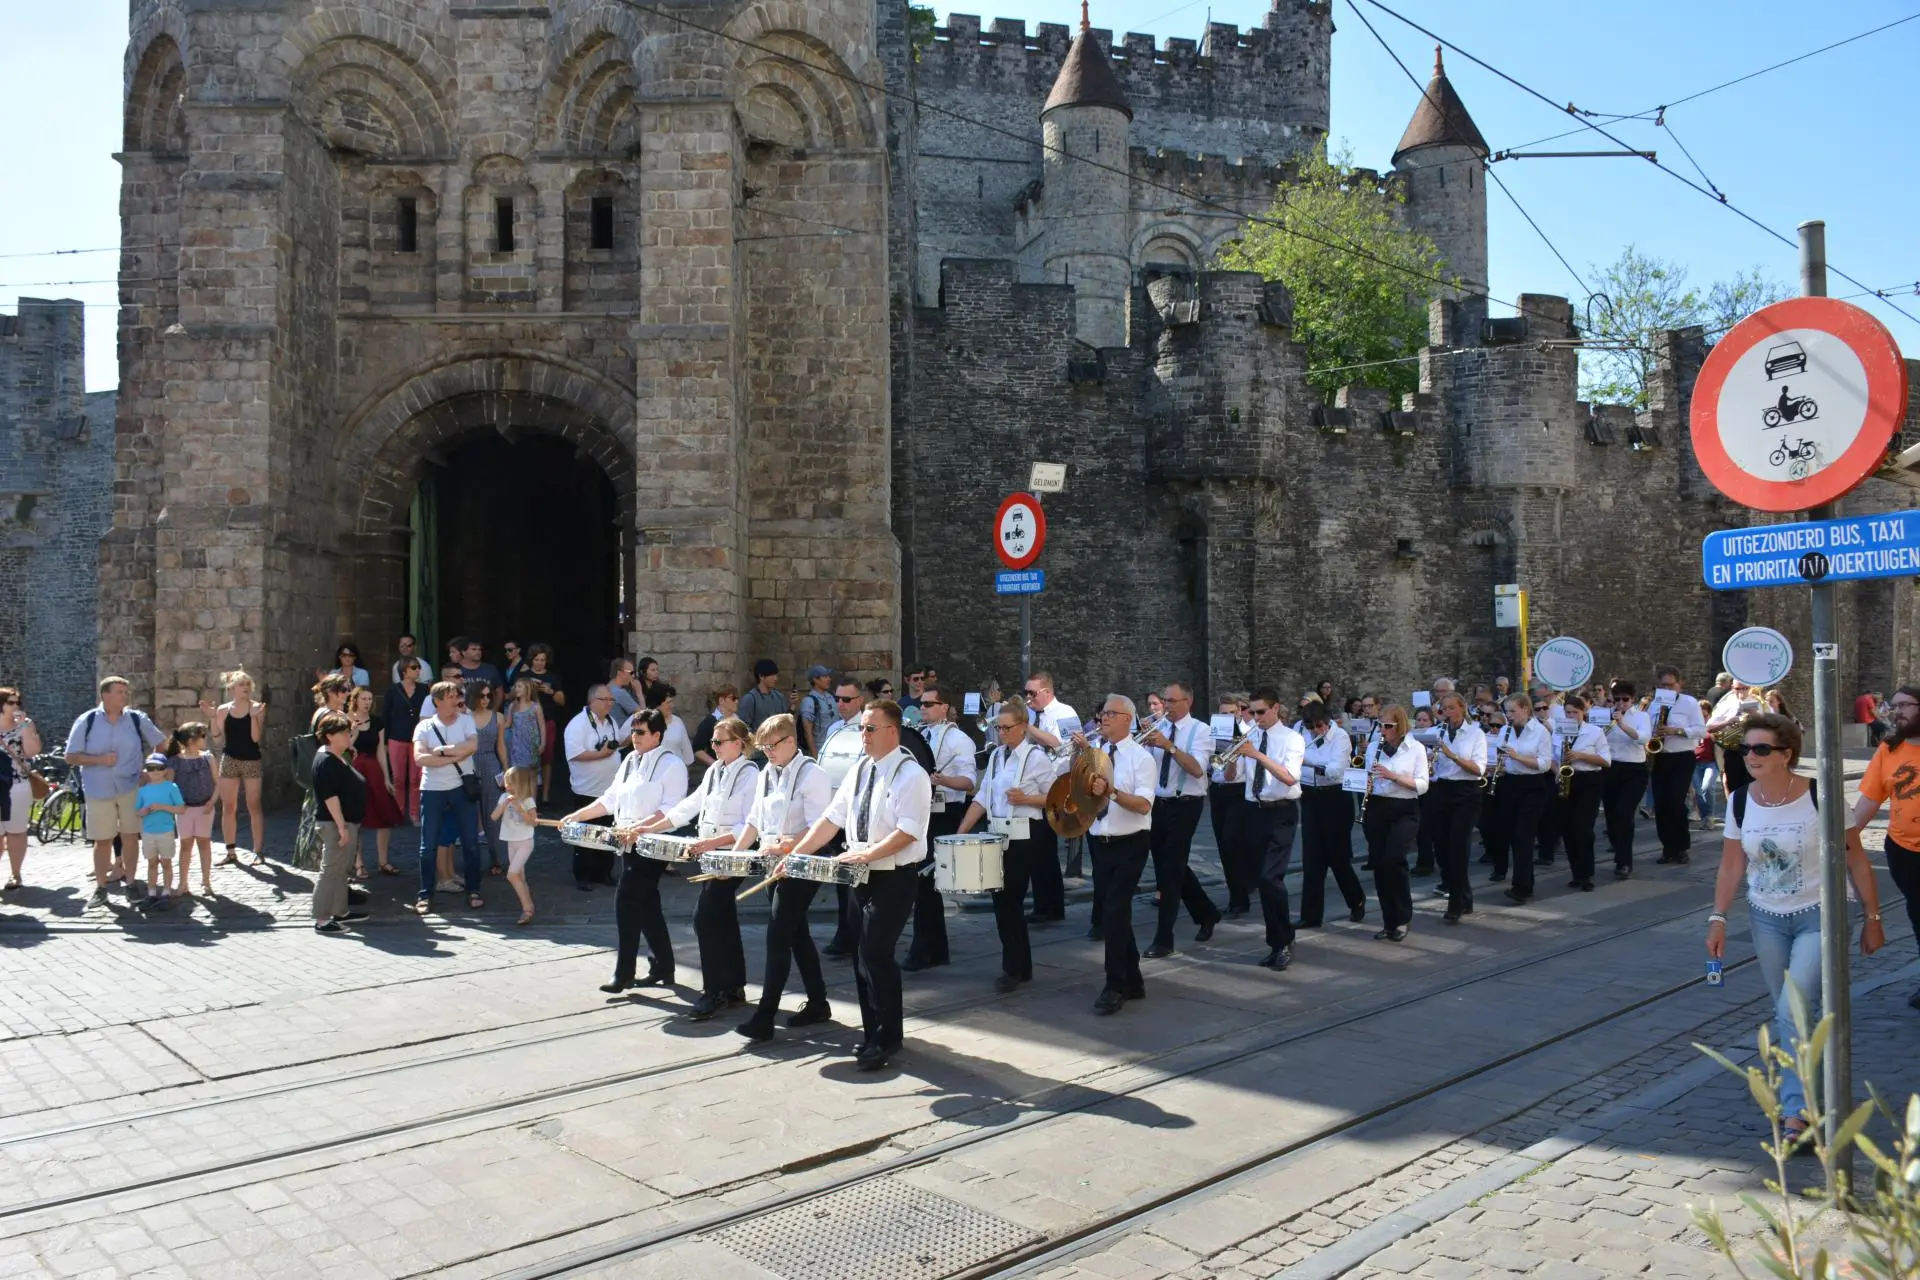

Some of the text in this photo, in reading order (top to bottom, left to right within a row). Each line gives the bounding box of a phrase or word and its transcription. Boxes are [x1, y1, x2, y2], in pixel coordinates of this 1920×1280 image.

[1722, 519, 1905, 557] UITGEZONDERD BUS, TAXI
[1713, 565, 1731, 584] EN
[1827, 547, 1920, 575] VOERTUIGEN
[1734, 641, 1779, 652] AMICITIA
